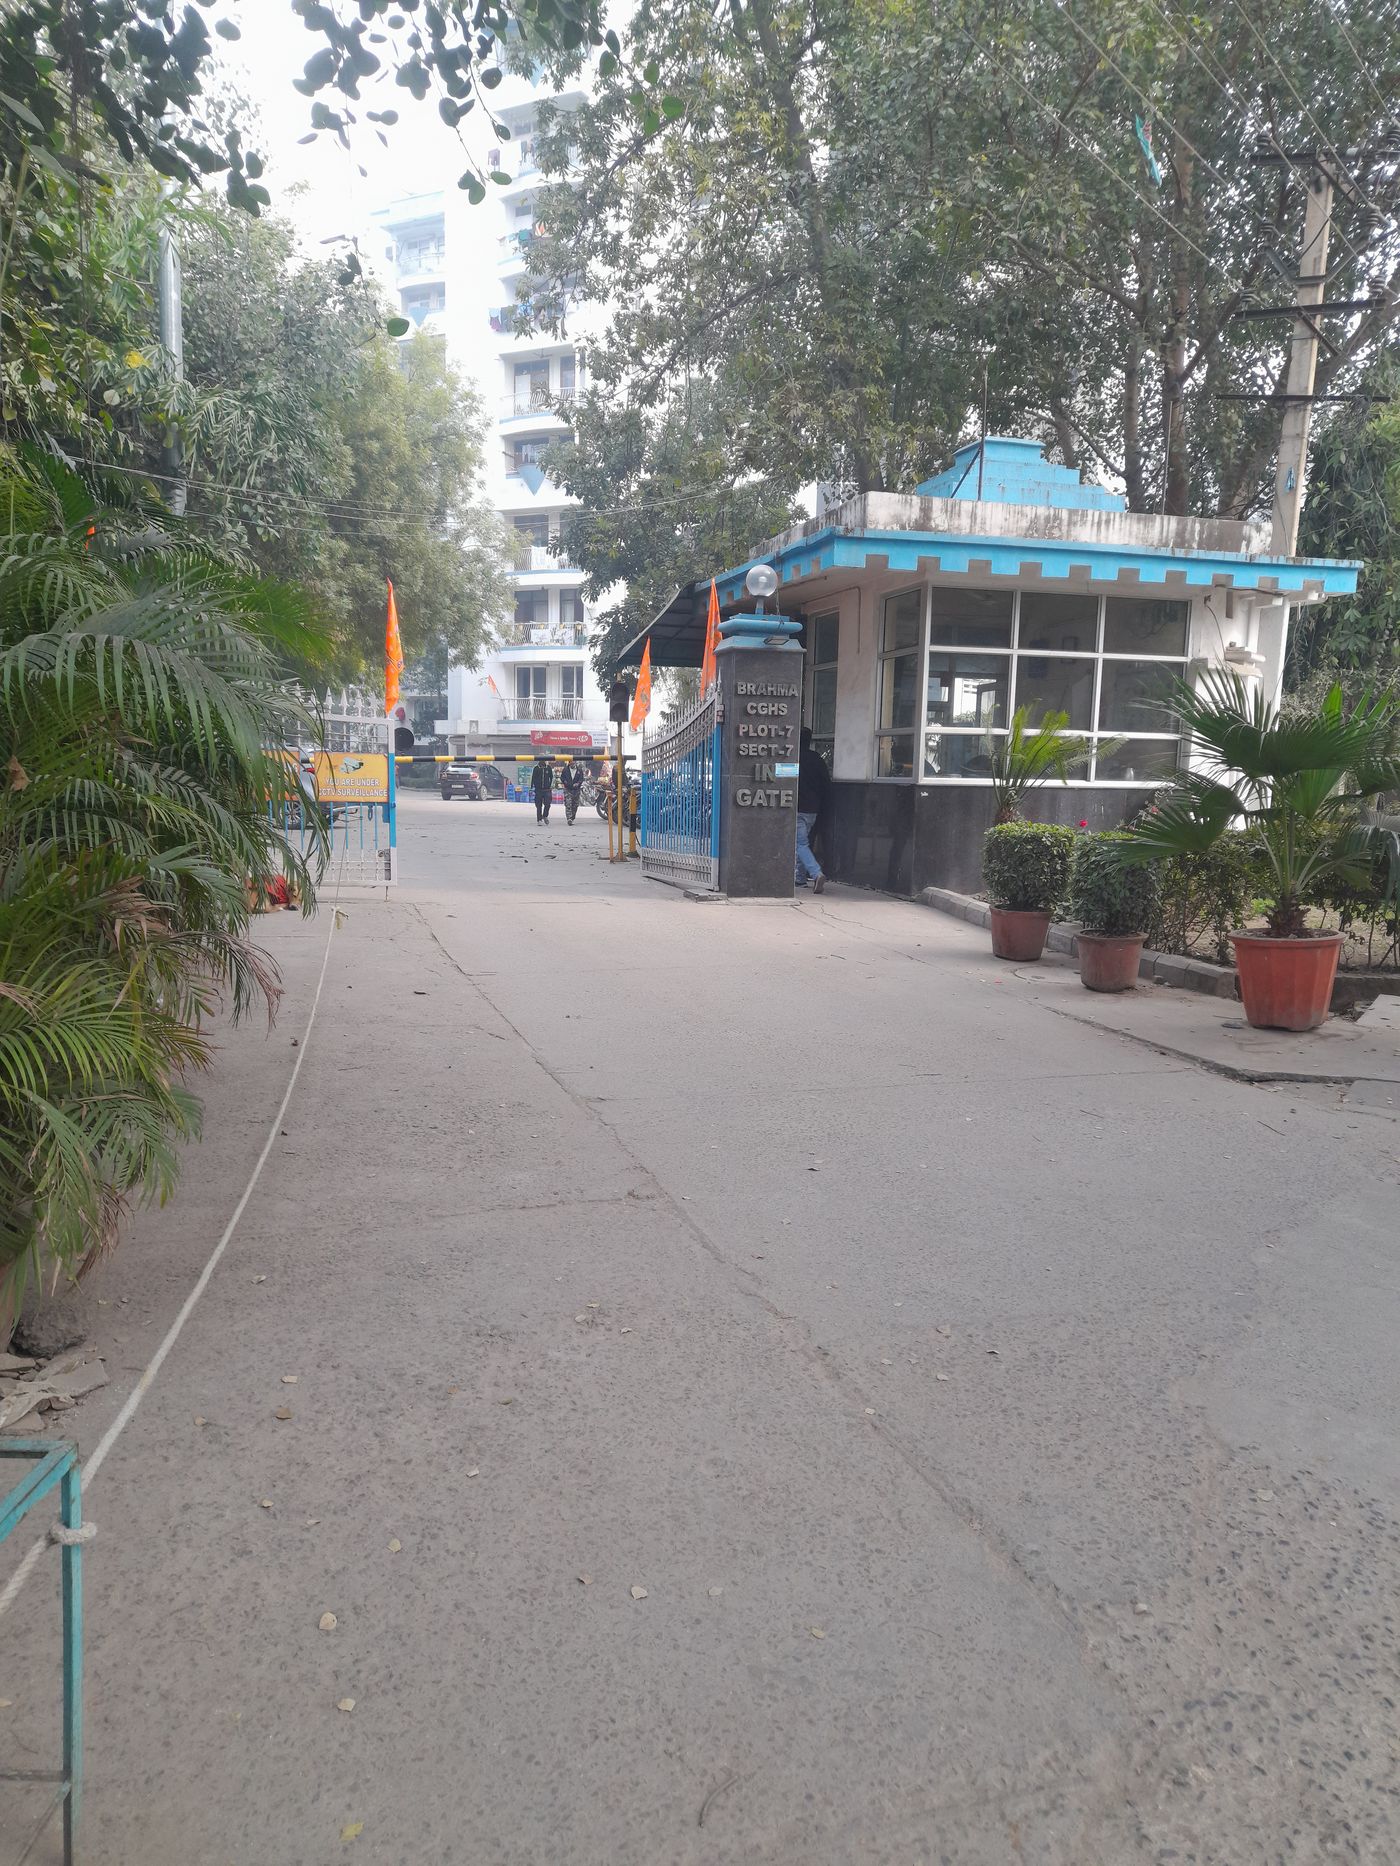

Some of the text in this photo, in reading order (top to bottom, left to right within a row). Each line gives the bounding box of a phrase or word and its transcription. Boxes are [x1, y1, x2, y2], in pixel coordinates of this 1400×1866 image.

[737, 681, 799, 697] BRAHMA
[747, 702, 788, 716] CGHS
[738, 723, 794, 738] PLOT-7
[739, 743, 794, 757] SECT-7
[326, 777, 379, 786] YOU ARE UNDER
[337, 788, 388, 797] SURVEILLANCE
[736, 788, 793, 807] GATE
